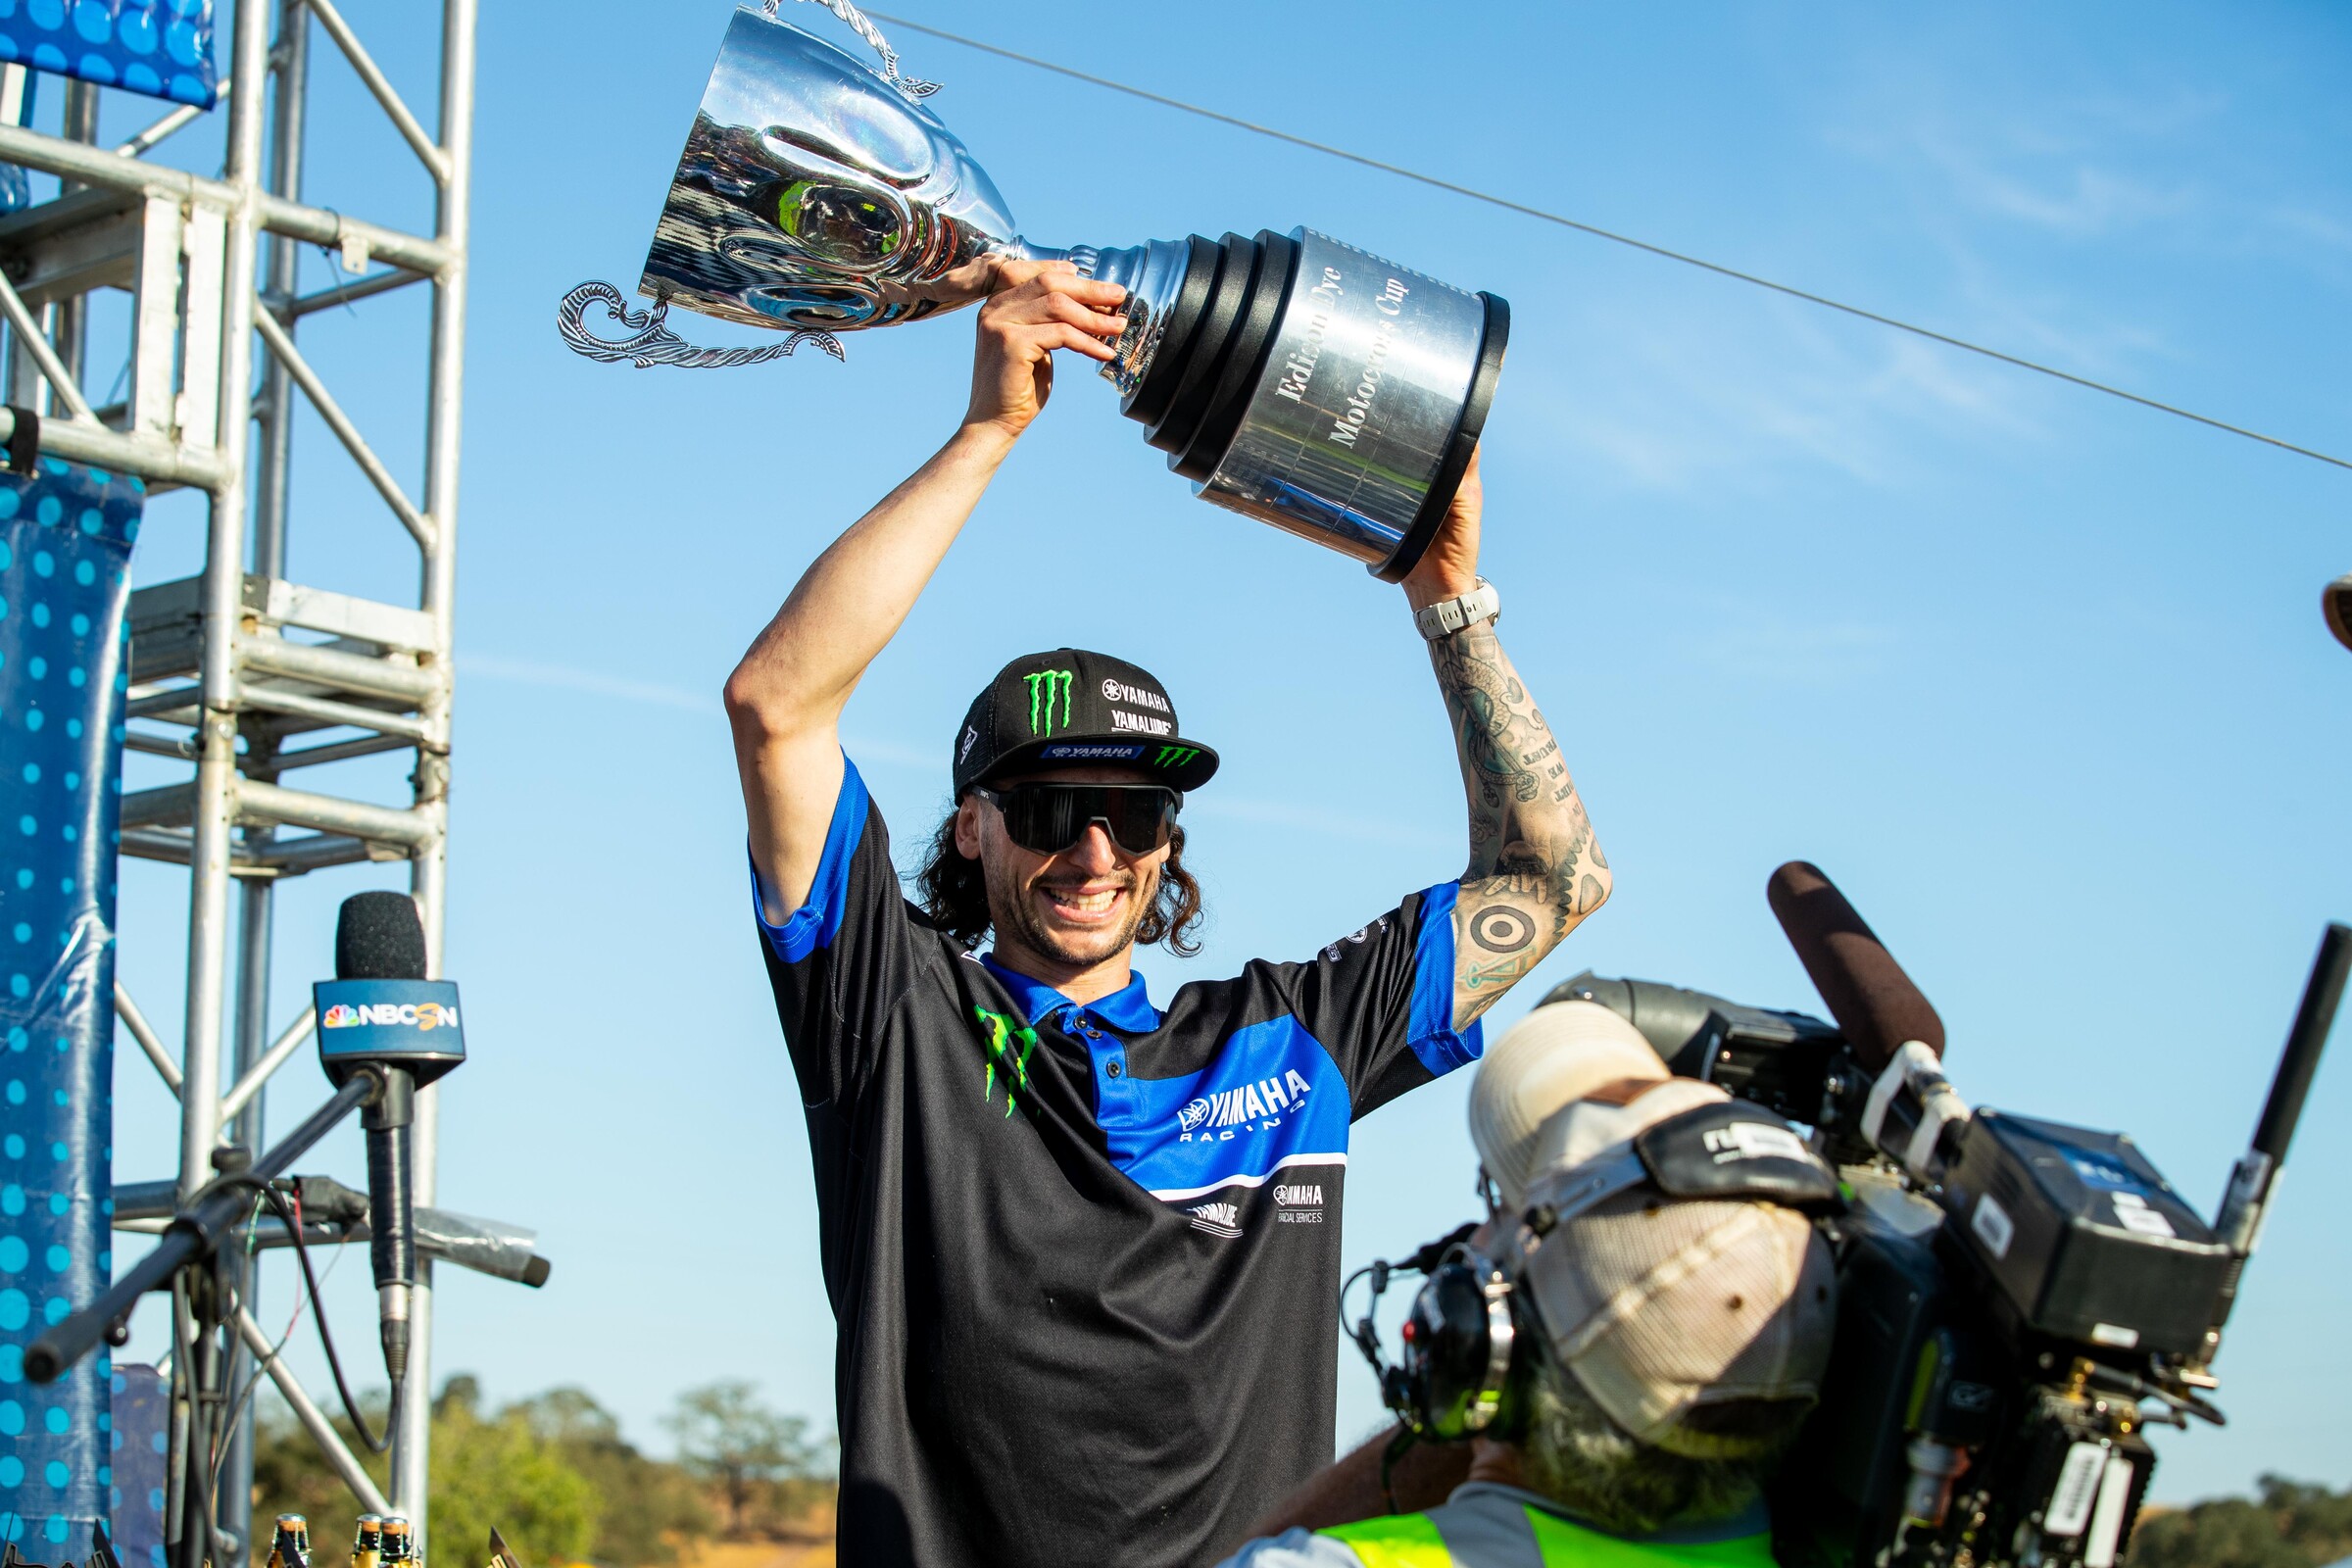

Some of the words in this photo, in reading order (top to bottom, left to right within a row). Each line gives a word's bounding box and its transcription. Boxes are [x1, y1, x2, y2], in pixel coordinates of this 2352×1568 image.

[1275, 312, 1328, 404] Edison
[1310, 267, 1345, 313] Dye
[1328, 317, 1395, 449] Motocross
[1375, 277, 1409, 317] Cup
[1119, 683, 1170, 712] YAMAHA
[1072, 747, 1133, 756] YAMAHA
[359, 1003, 459, 1032] NBCSN
[1205, 1068, 1311, 1128] YAMAHA
[1179, 1099, 1305, 1143] RACING
